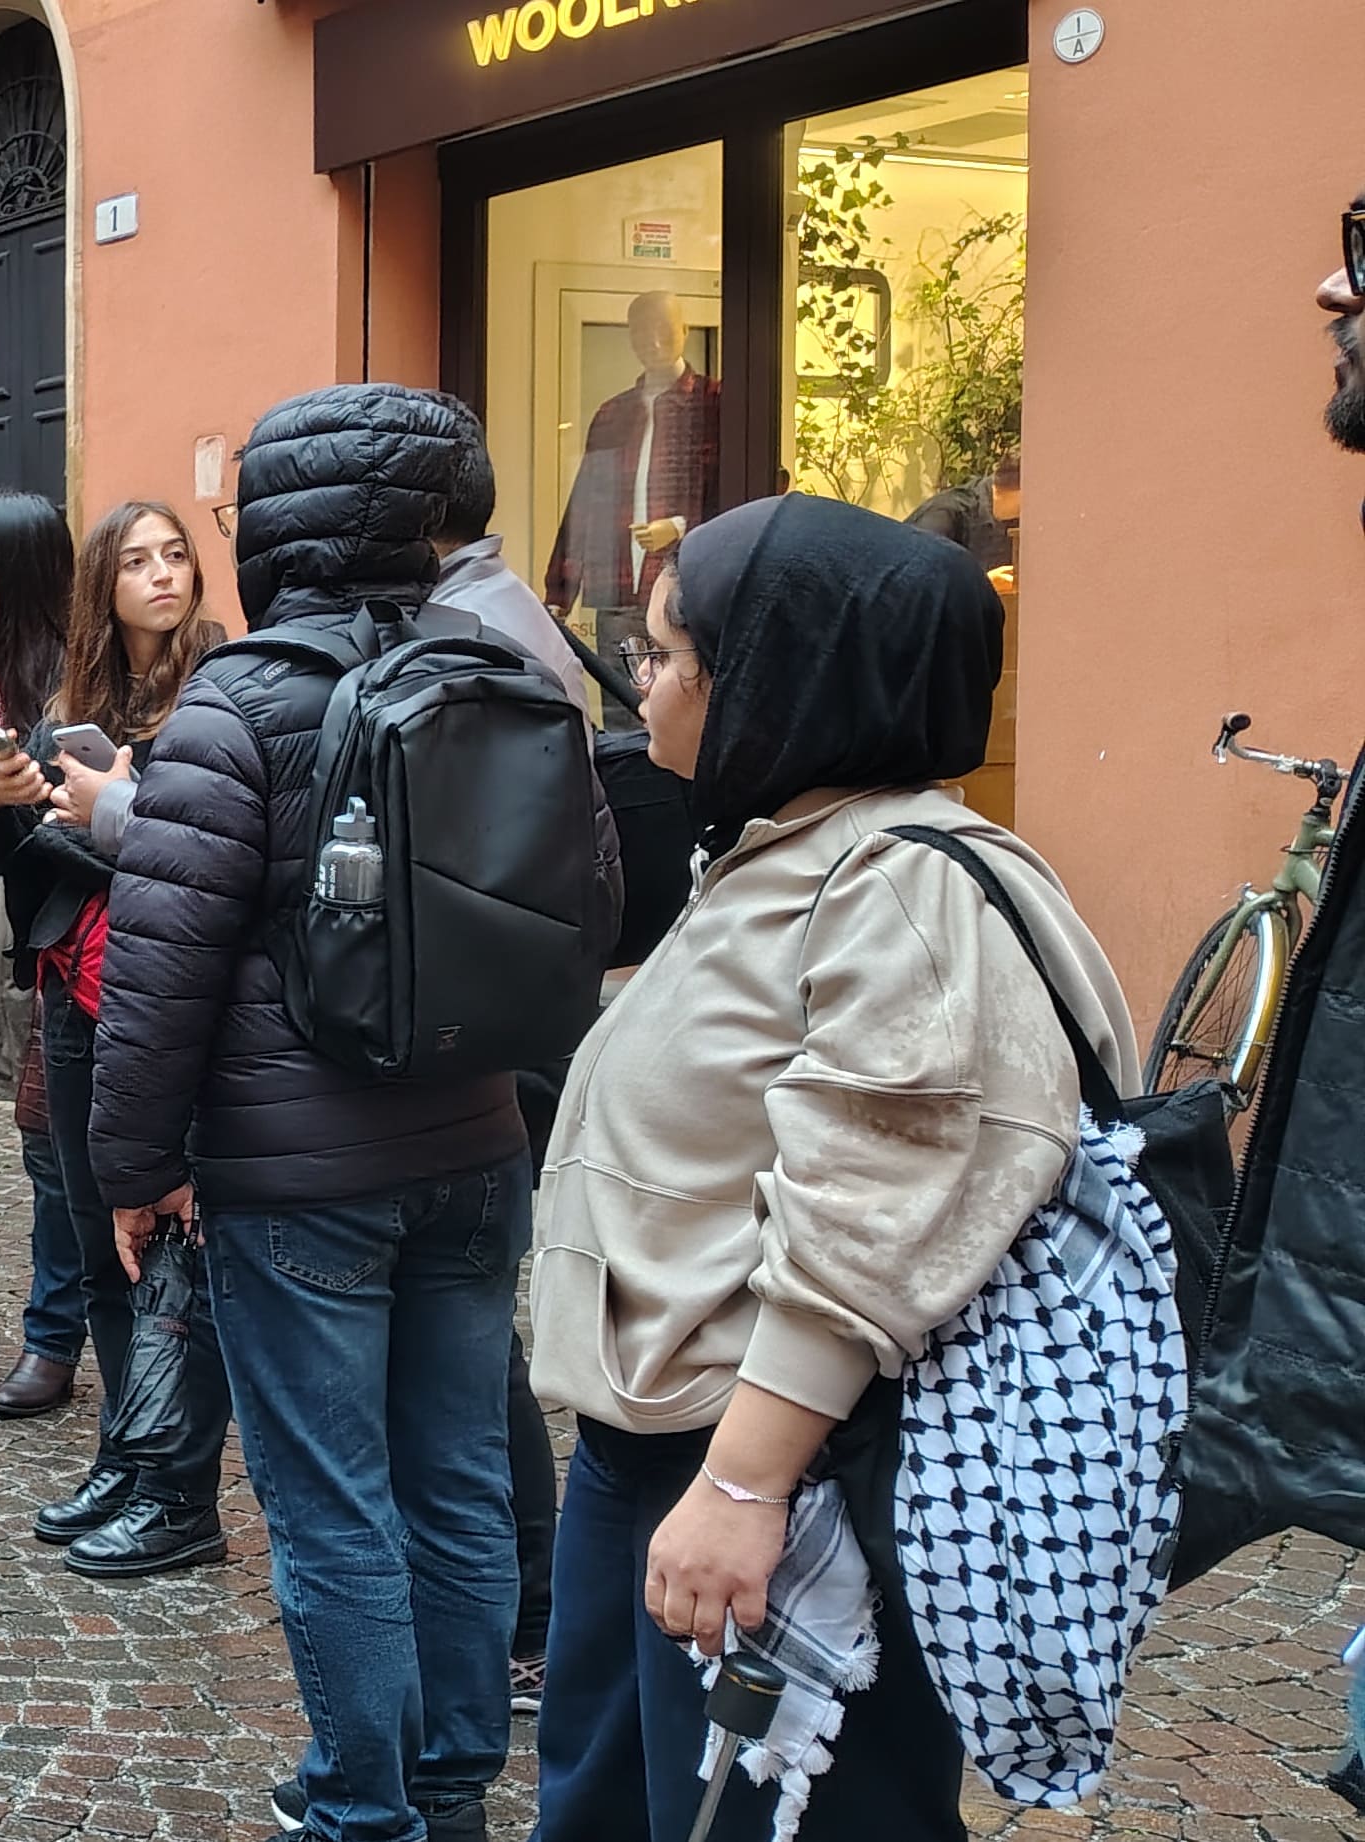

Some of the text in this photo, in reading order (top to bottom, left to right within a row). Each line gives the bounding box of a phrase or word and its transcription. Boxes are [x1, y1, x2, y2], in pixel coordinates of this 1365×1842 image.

[467, 0, 698, 66] WOOL
[1073, 38, 1084, 56] A
[110, 205, 118, 232] 1
